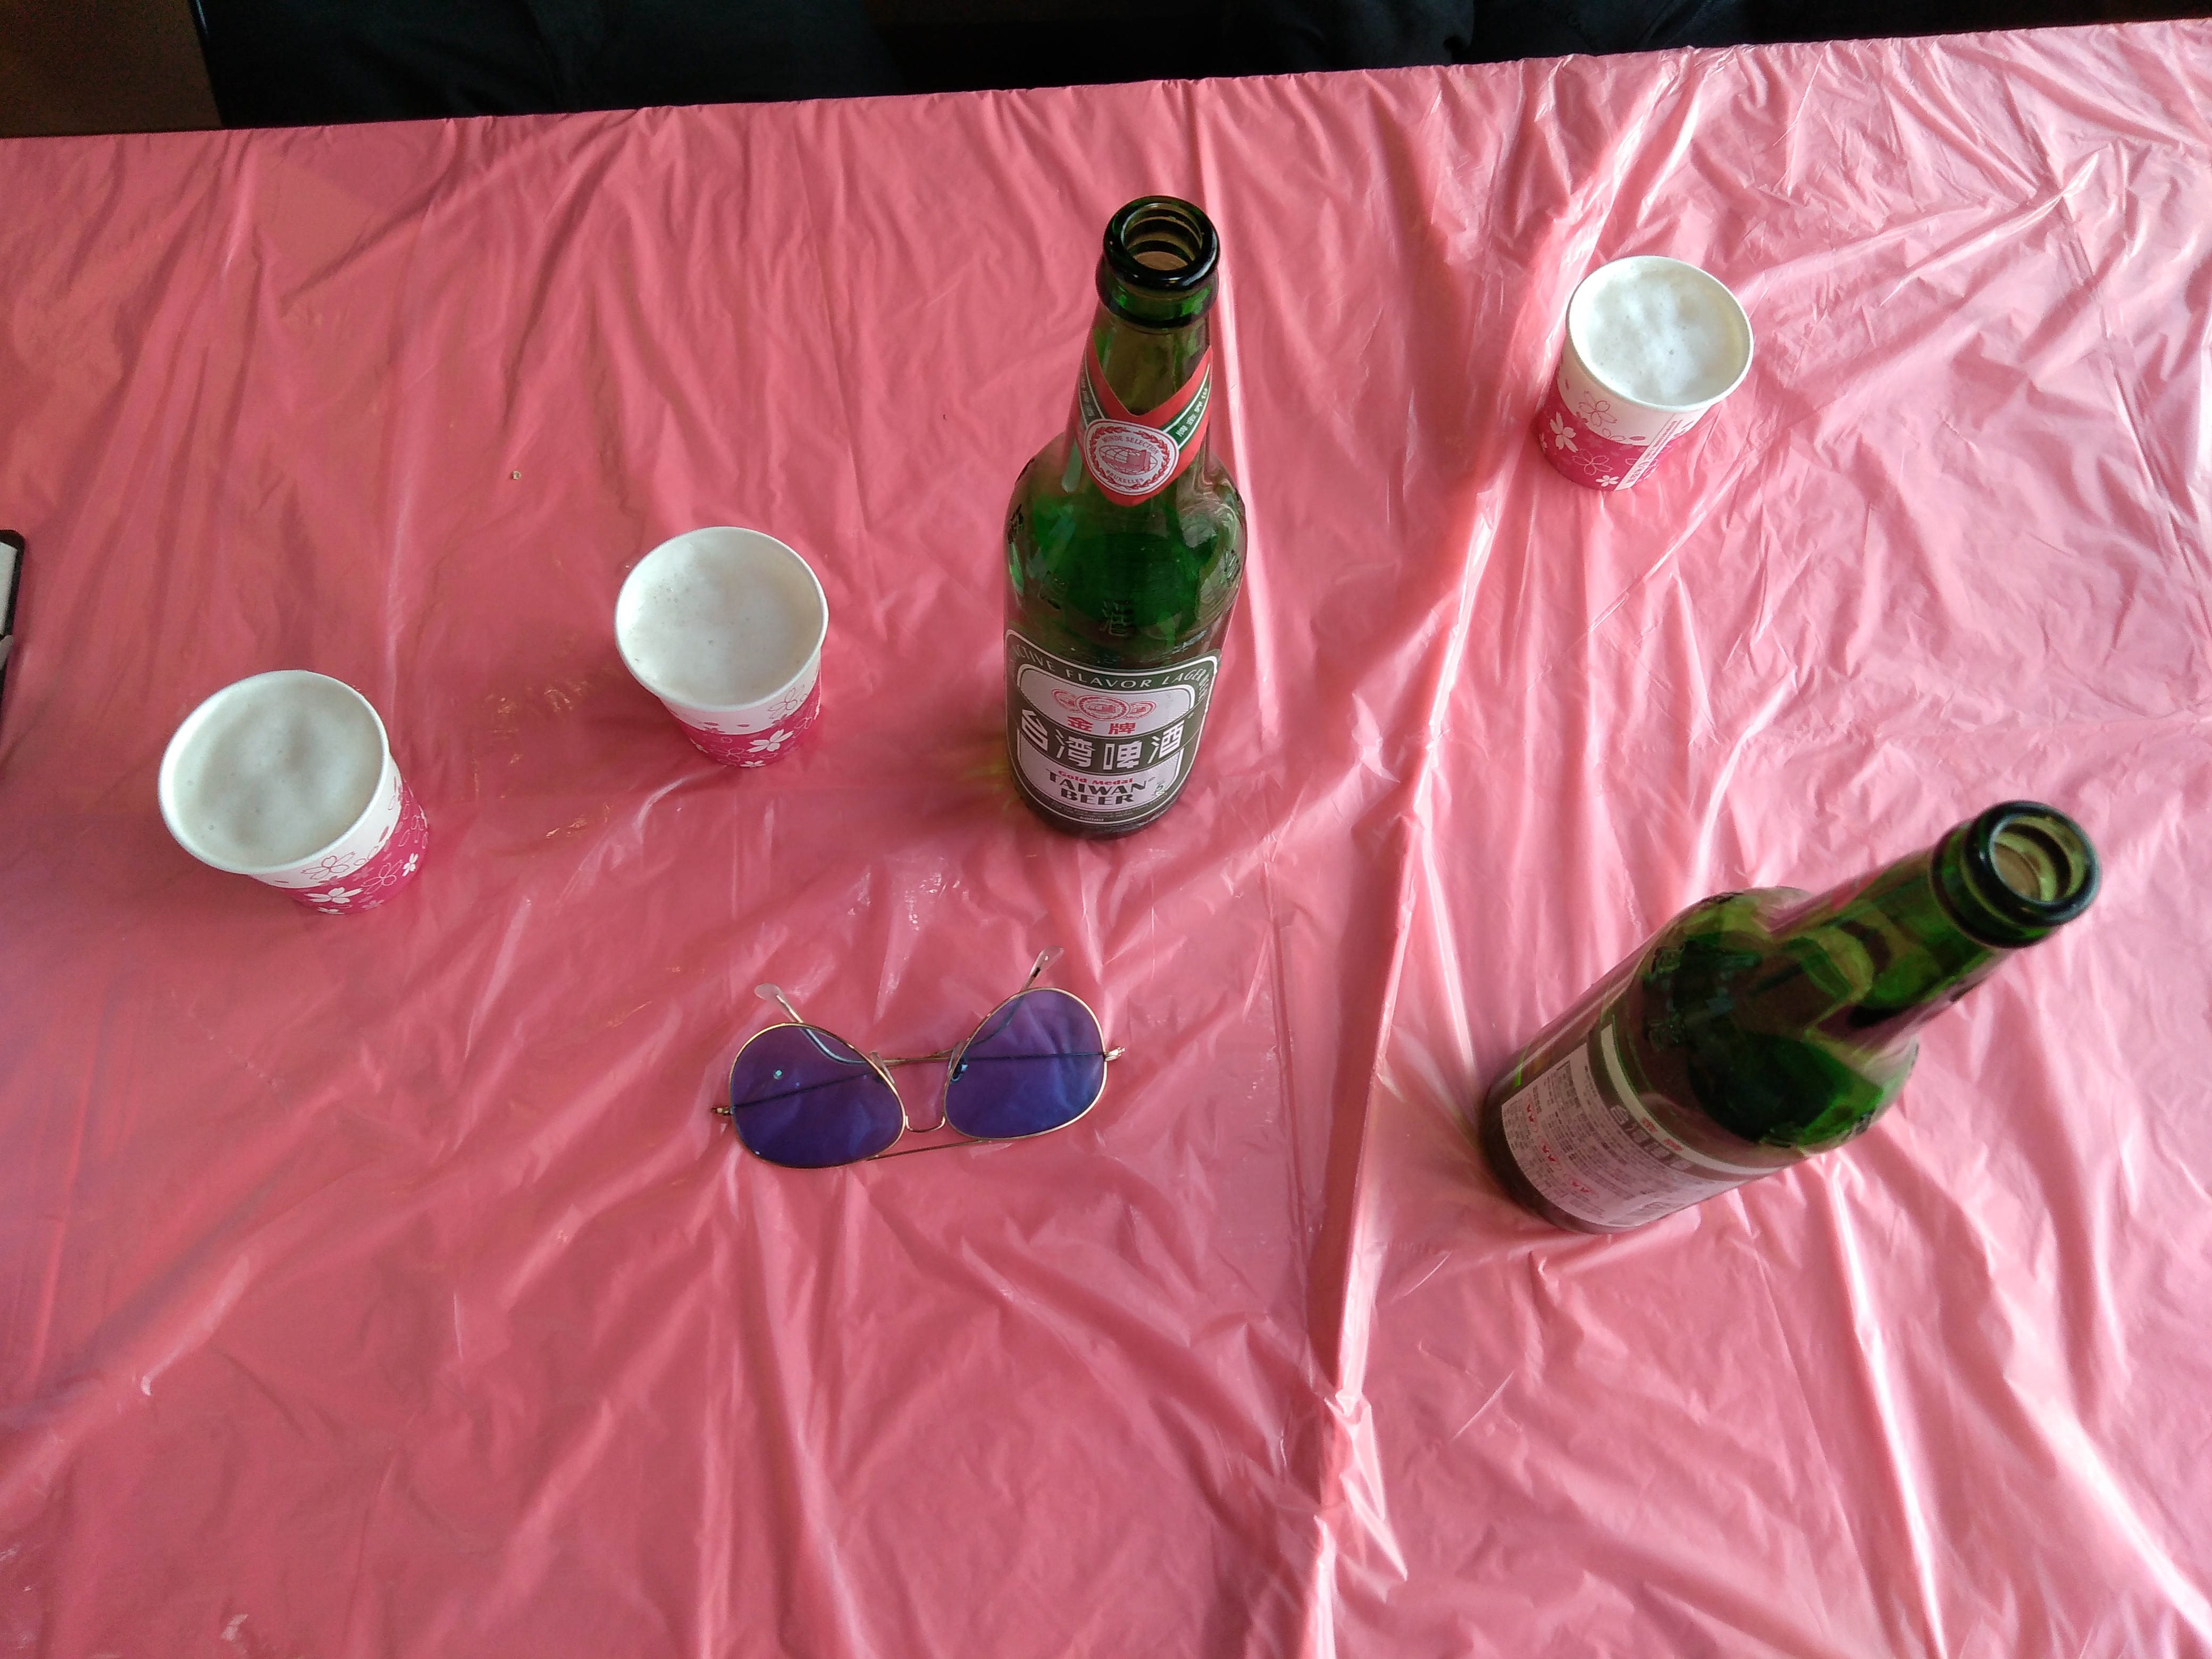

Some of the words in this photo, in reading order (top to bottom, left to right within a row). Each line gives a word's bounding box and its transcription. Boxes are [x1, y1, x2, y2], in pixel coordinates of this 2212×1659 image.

[1125, 435, 1160, 455] SELECTION
[1105, 470, 1144, 484] BRUXELLES
[1066, 668, 1152, 689] FLAVOR
[1161, 668, 1206, 685] LAGER
[1067, 716, 1136, 735] 金牌
[1021, 709, 1185, 770] 台湾啤酒
[1045, 768, 1147, 796] TAIWAN
[1058, 770, 1088, 784] Gold
[1091, 777, 1134, 786] Medal
[1061, 787, 1134, 806] BEER
